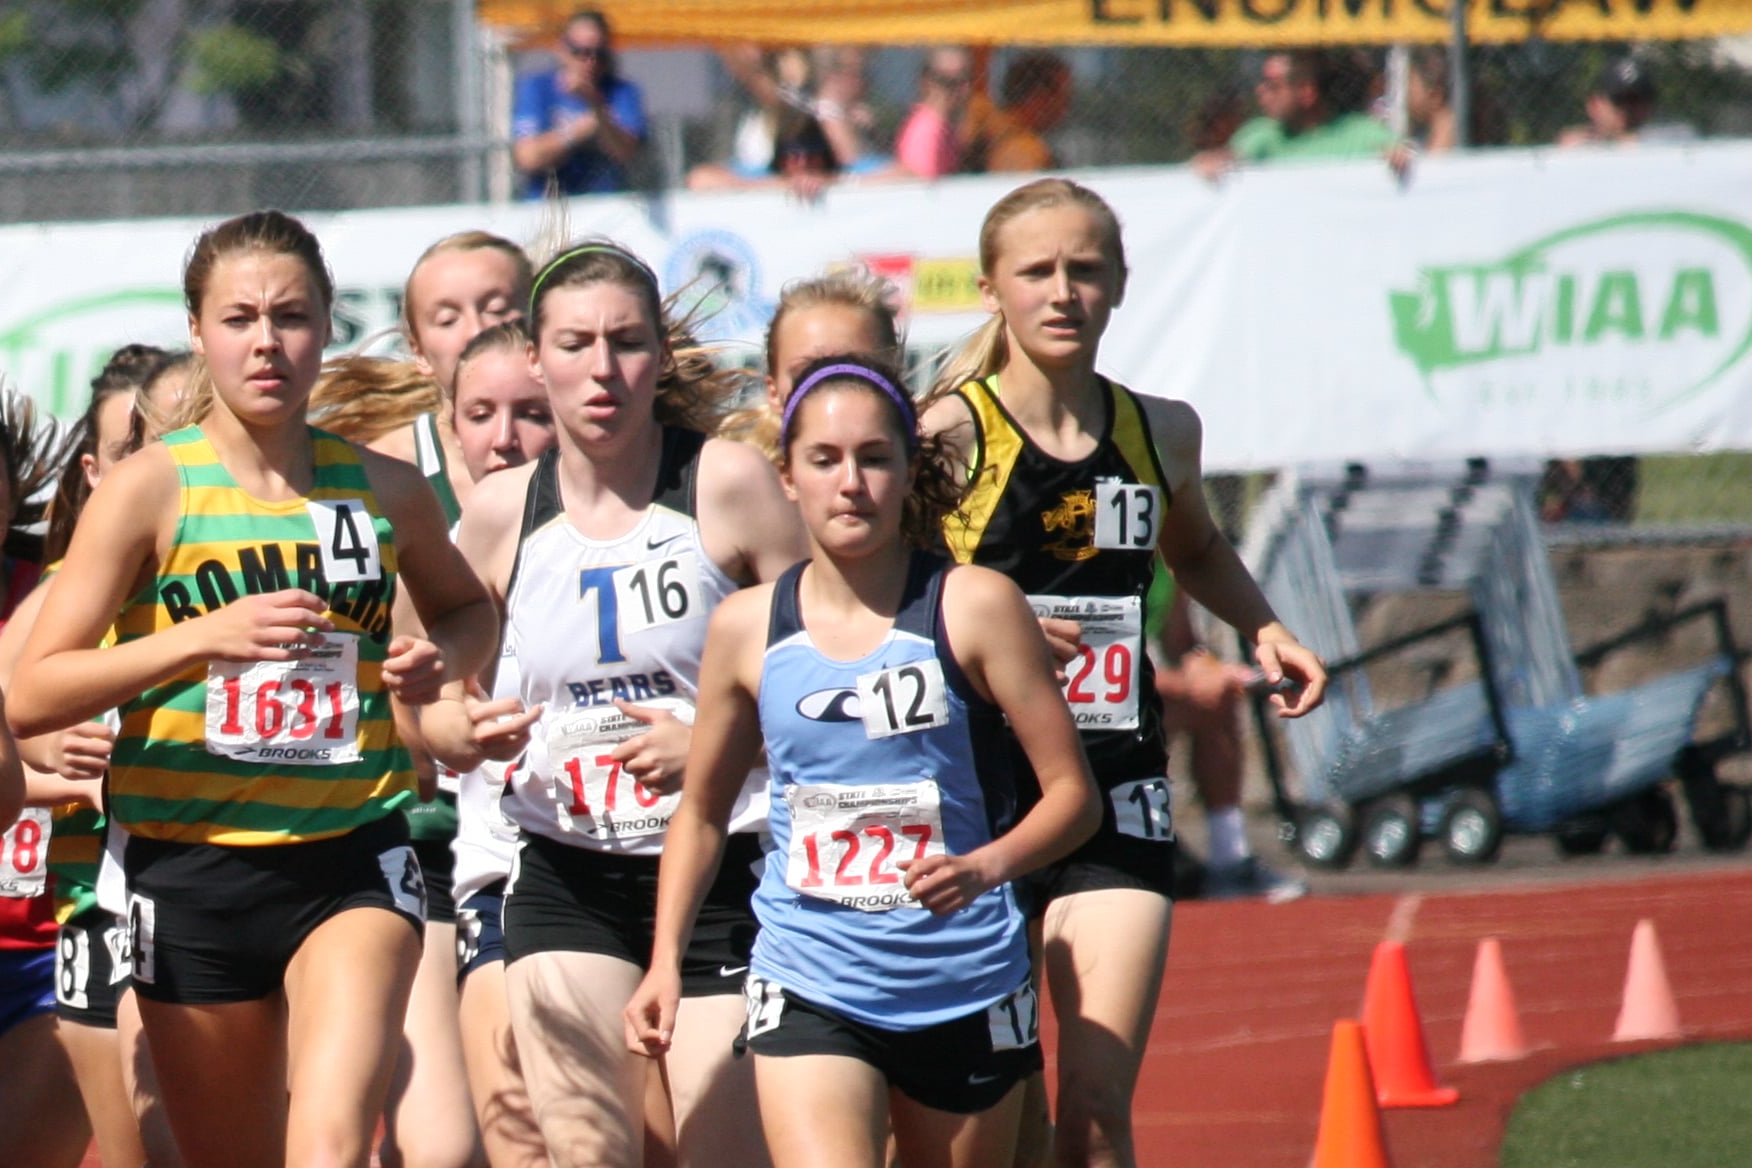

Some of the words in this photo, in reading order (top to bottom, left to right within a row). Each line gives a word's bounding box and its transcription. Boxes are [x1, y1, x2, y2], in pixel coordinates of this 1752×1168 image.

[1449, 267, 1720, 351] WIAA
[333, 504, 371, 575] 4
[1111, 488, 1154, 547] 13
[629, 560, 688, 624] 16
[567, 671, 677, 707] BEARS
[871, 667, 935, 730] 12
[1067, 644, 1132, 703] 29
[221, 676, 344, 739] 1631
[258, 747, 332, 760] BROOKS
[564, 755, 661, 816] 17
[1129, 780, 1172, 837] 13
[610, 816, 673, 833] BROOK
[801, 824, 932, 888] 1227
